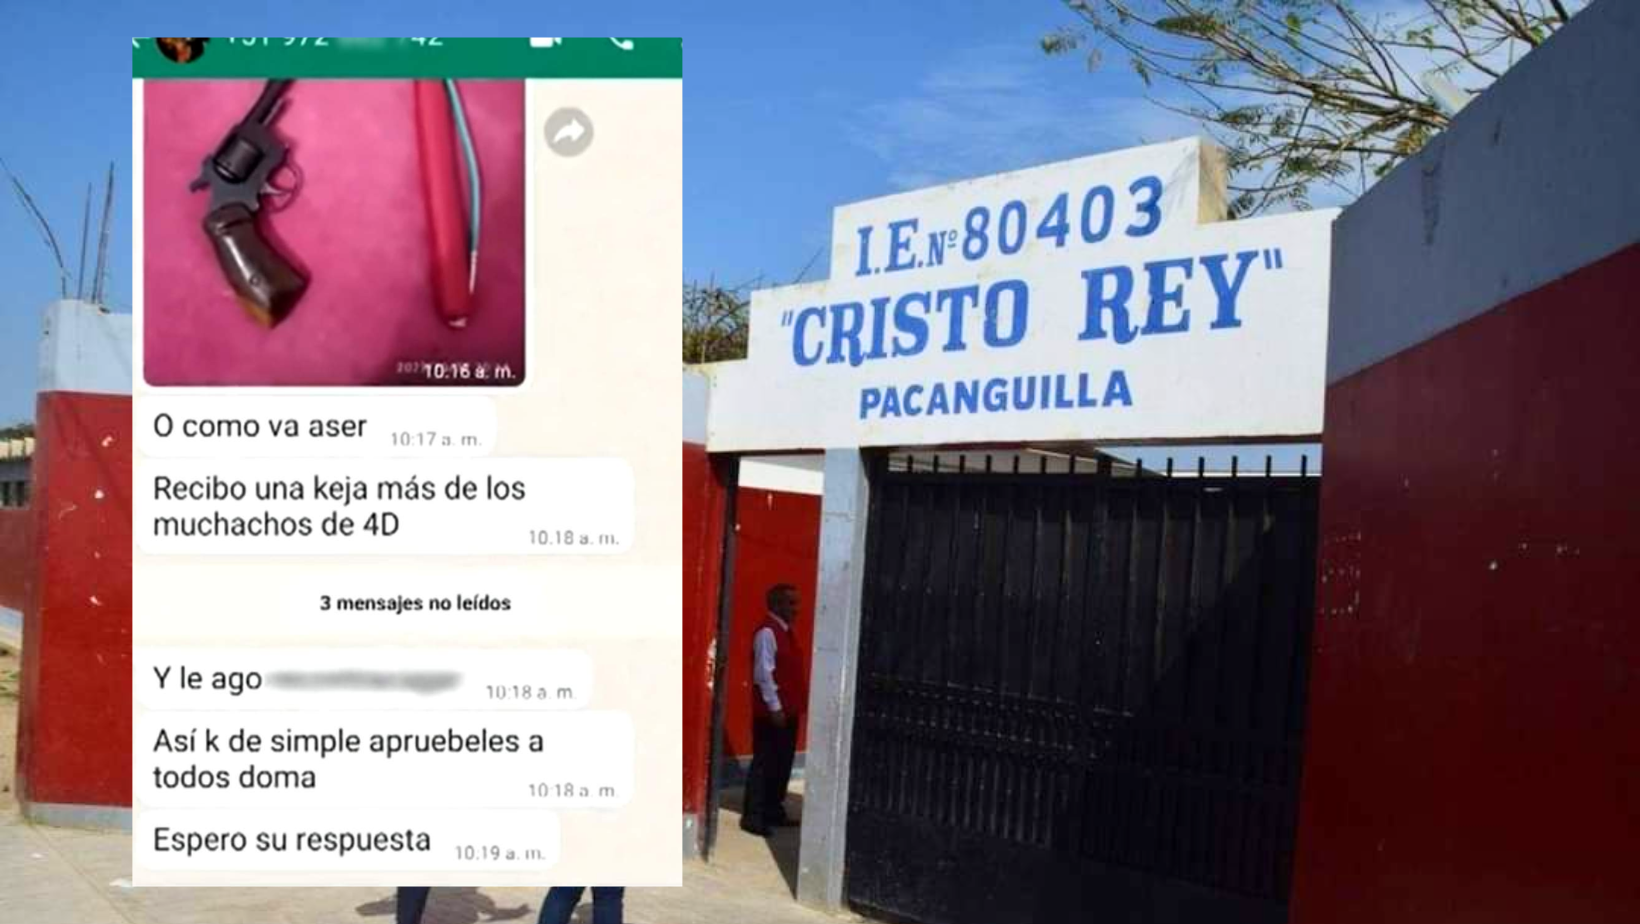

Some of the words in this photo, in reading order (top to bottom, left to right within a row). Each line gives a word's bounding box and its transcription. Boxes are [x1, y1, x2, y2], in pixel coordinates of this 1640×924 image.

[961, 175, 1164, 261] 80403
[780, 279, 1030, 368] "CRISTO
[1077, 248, 1284, 345] REY"
[858, 369, 1134, 420] PACANGUILLA
